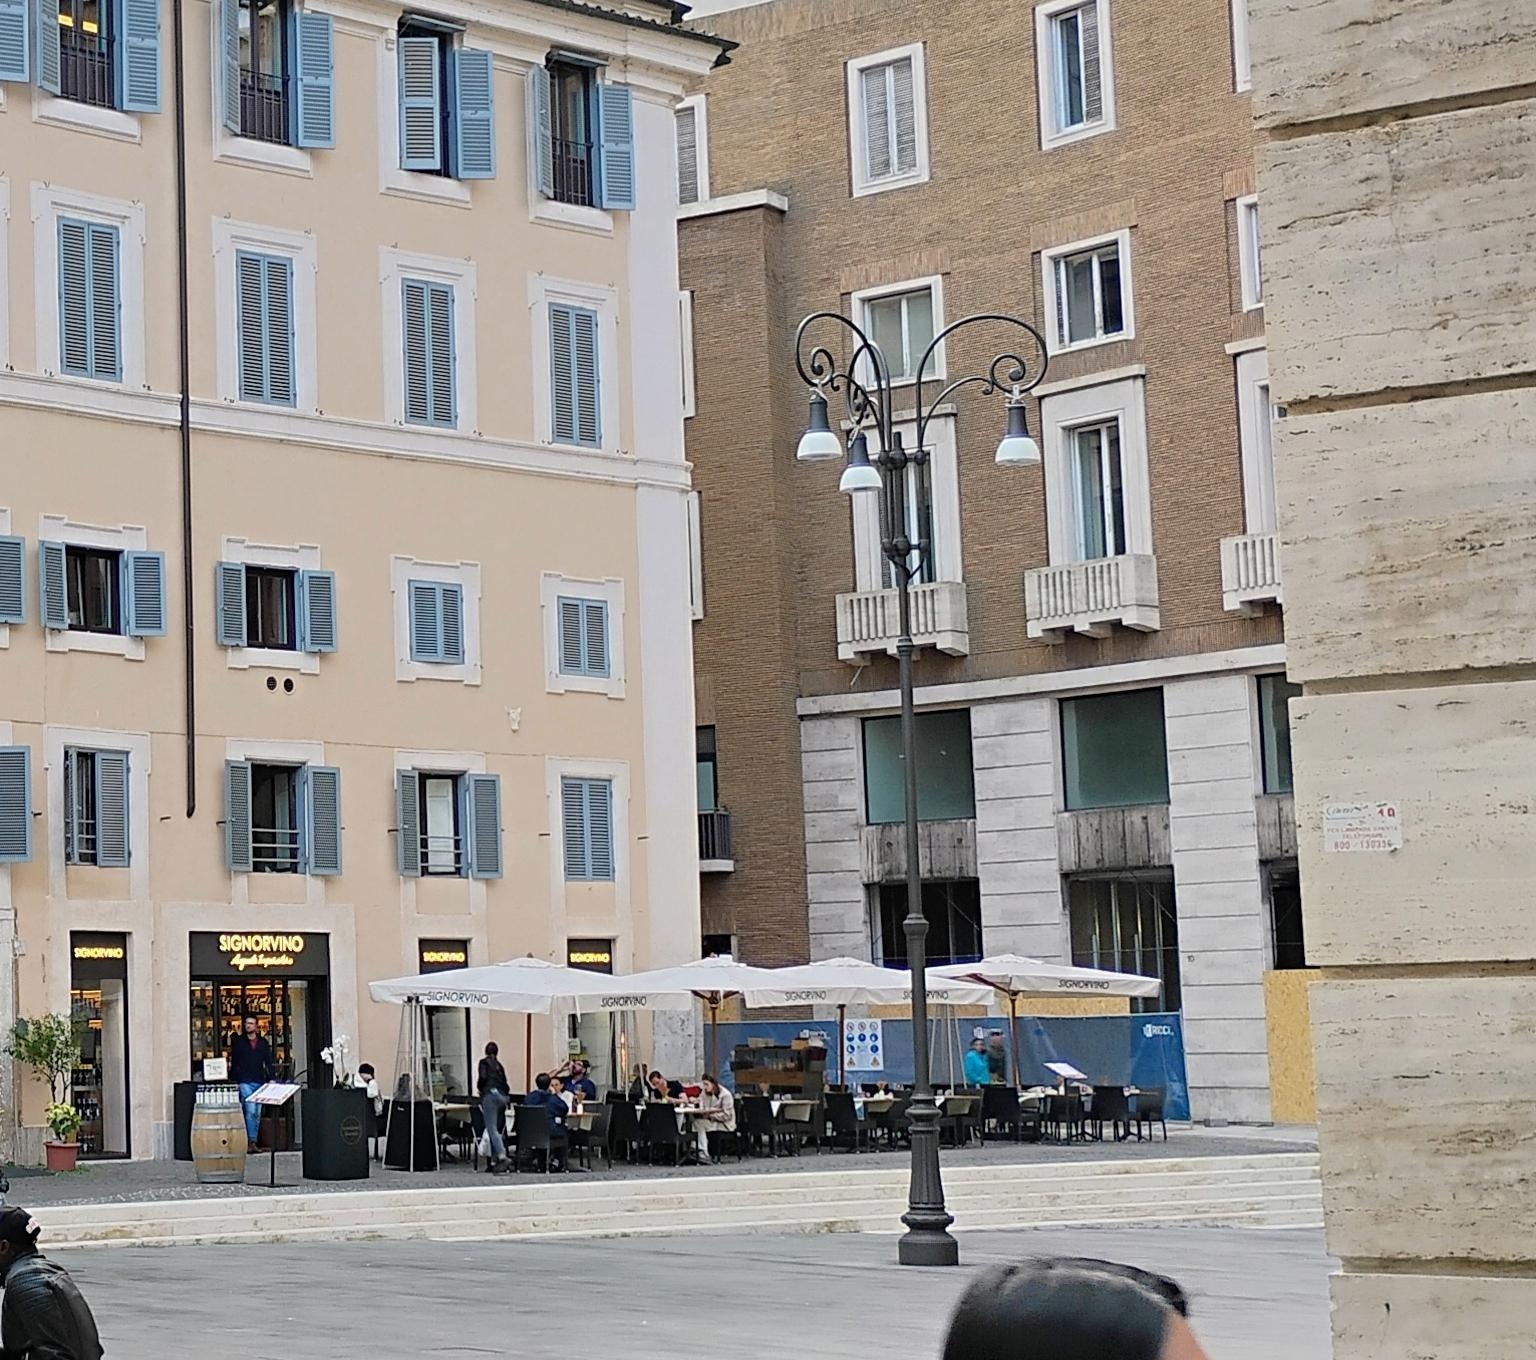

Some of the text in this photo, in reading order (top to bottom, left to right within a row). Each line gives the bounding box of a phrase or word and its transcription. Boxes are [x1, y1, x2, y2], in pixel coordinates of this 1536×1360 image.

[219, 934, 304, 953] SIGNORVINO
[74, 947, 124, 959] SIGNORVINO
[423, 951, 465, 963] SIGNORVINO
[569, 952, 610, 963] SIGNORVINO
[1058, 979, 1110, 990] SIGNORVINO
[427, 991, 489, 1005] SIGNORVINO
[600, 995, 647, 1008] SIGNORVINO
[784, 990, 827, 1002] SIGNORVINO
